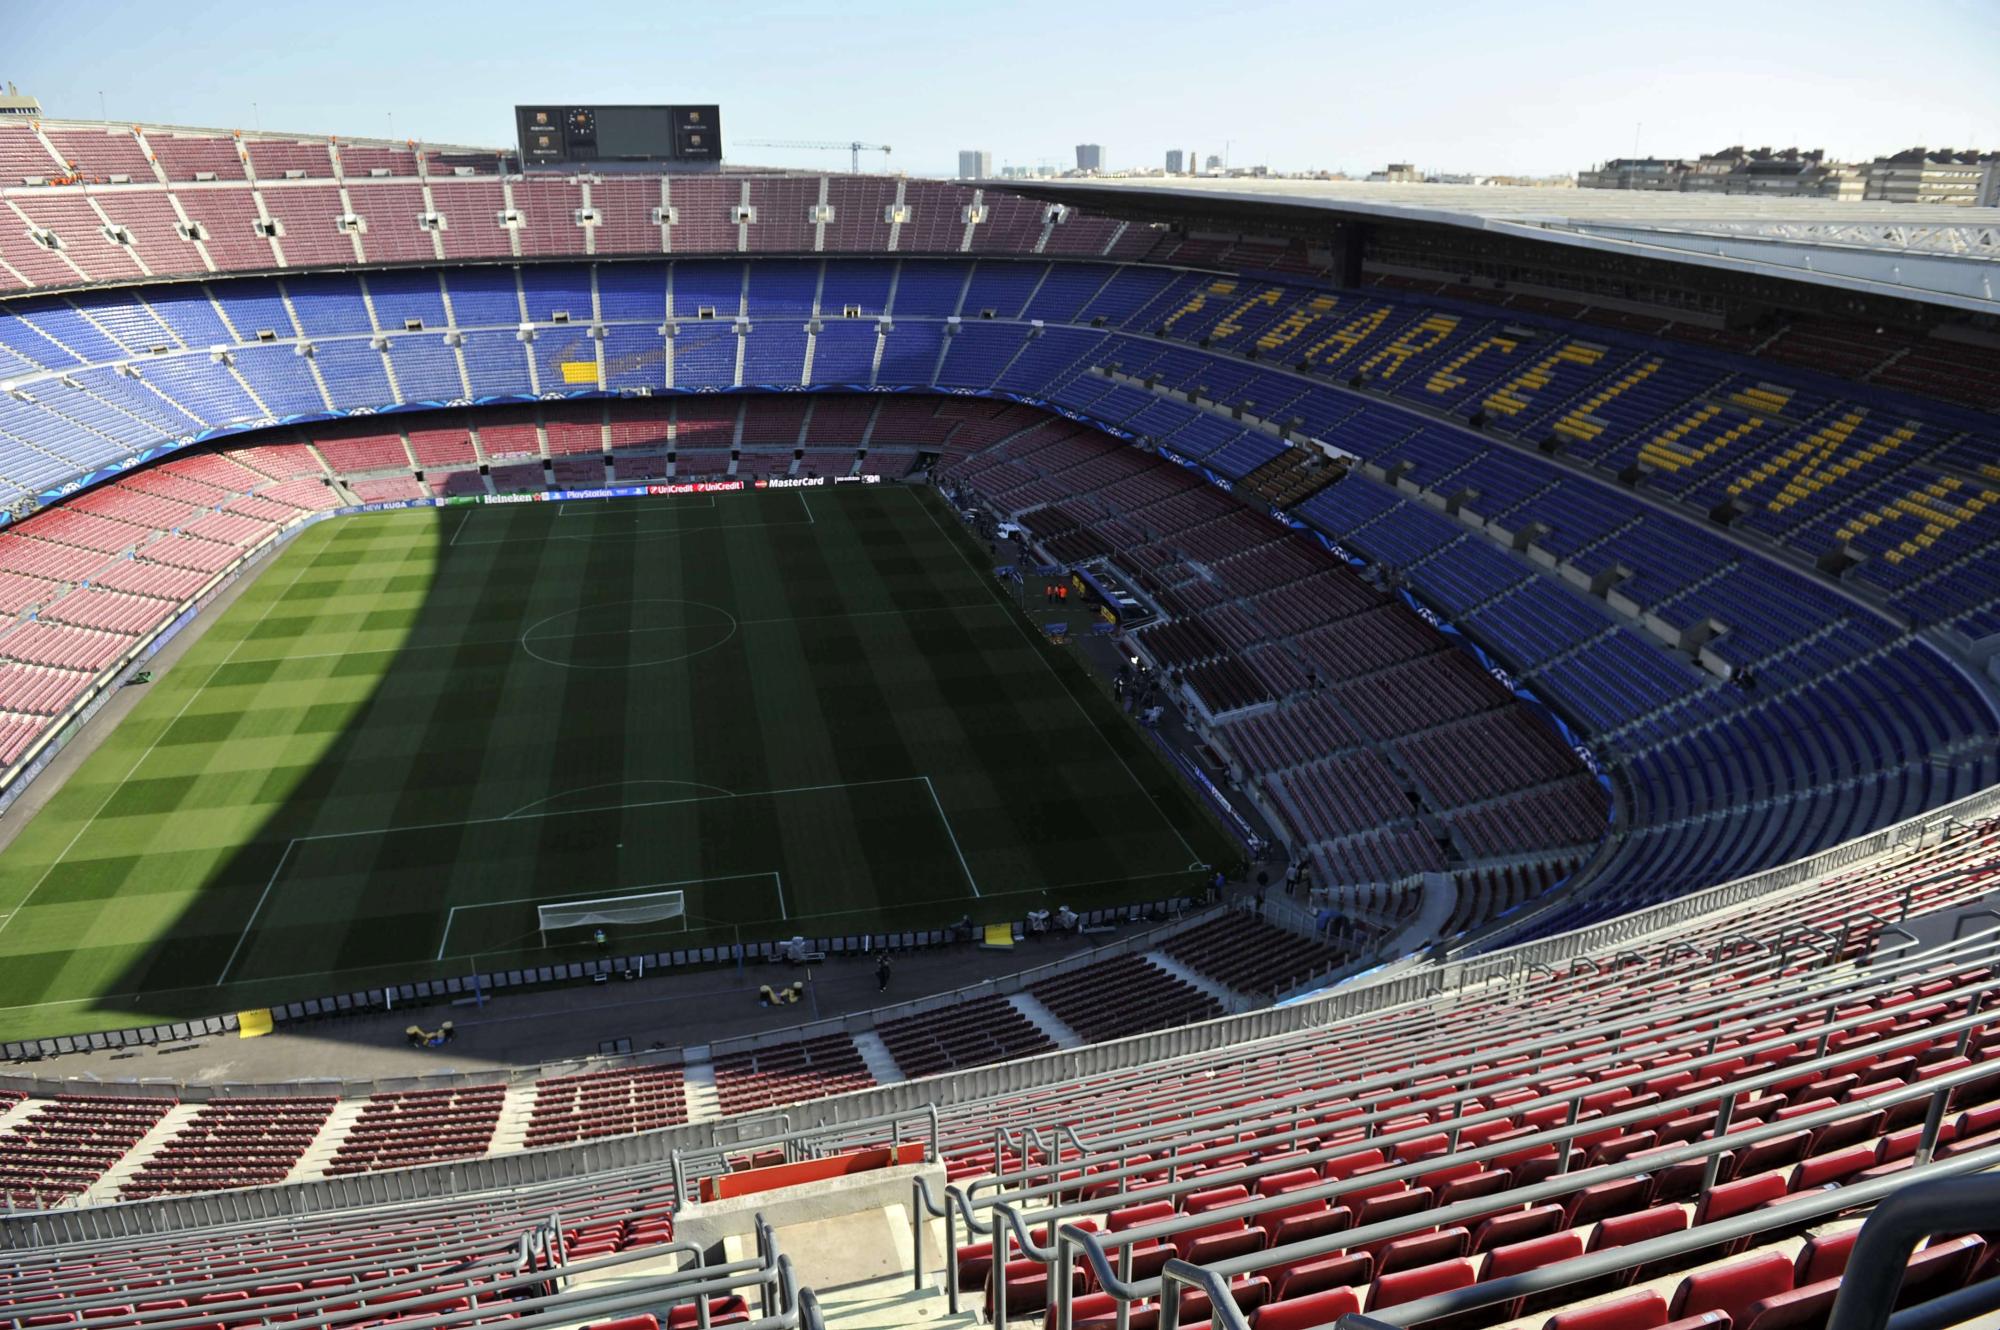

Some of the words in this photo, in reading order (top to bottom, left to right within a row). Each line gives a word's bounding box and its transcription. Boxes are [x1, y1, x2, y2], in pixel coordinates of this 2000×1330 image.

[705, 482, 740, 491] UniCredit
[769, 477, 824, 488] MasterCard
[658, 485, 693, 494] UniCredit
[484, 494, 532, 504] Heineken
[567, 490, 613, 499] PlayStation
[363, 504, 381, 512] NEW
[383, 501, 407, 509] KUGA
